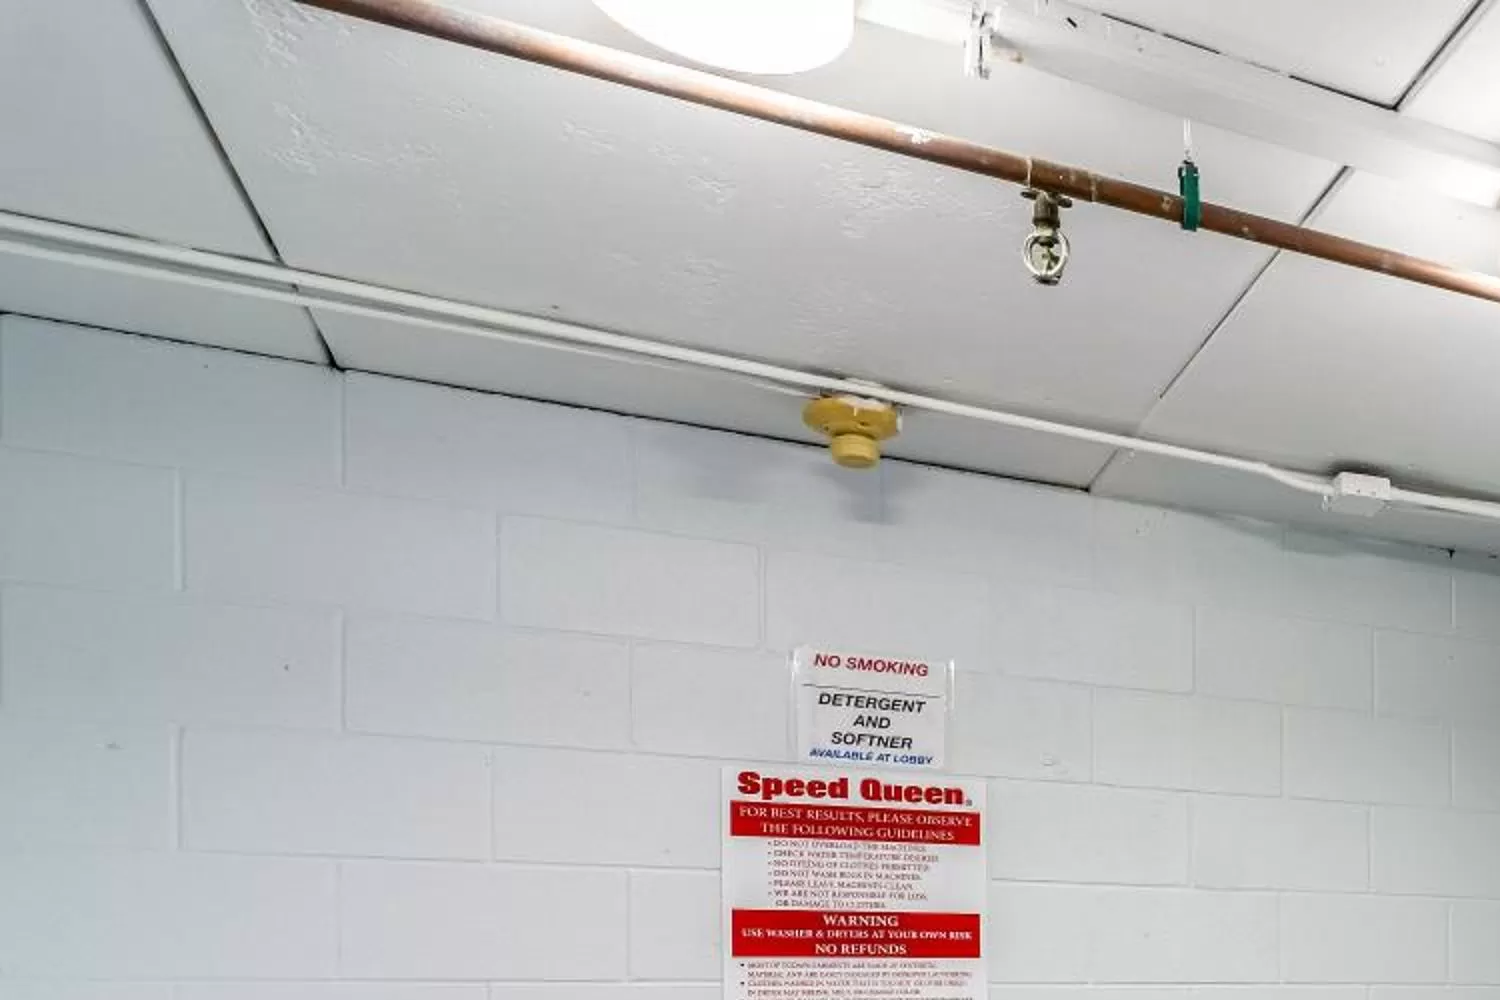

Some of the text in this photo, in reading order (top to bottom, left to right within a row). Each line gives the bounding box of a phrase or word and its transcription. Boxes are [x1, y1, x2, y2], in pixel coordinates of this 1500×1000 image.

[814, 653, 929, 677] NO SMOKING
[818, 692, 927, 713] DETERGENT
[853, 714, 891, 729] AND
[831, 731, 913, 750] SOFTNER
[809, 748, 934, 765] AVAILABLE AT LOBBY
[737, 771, 965, 804] Speed Queen
[739, 805, 767, 817] FOR
[771, 807, 802, 818] BEST
[867, 812, 914, 824] PLEASE
[916, 814, 973, 827] OBSERVE
[762, 823, 955, 840] THE FOLLOWING GUIDELINES
[823, 914, 899, 927] WARNING
[742, 928, 763, 938] USE
[766, 928, 813, 938] WASHER
[827, 929, 869, 939] DRYERS
[871, 929, 885, 939] AT
[888, 930, 917, 939] YOUR
[919, 931, 946, 939] OWN
[949, 931, 973, 940] RISK
[815, 943, 907, 955] NO REFUNDS
